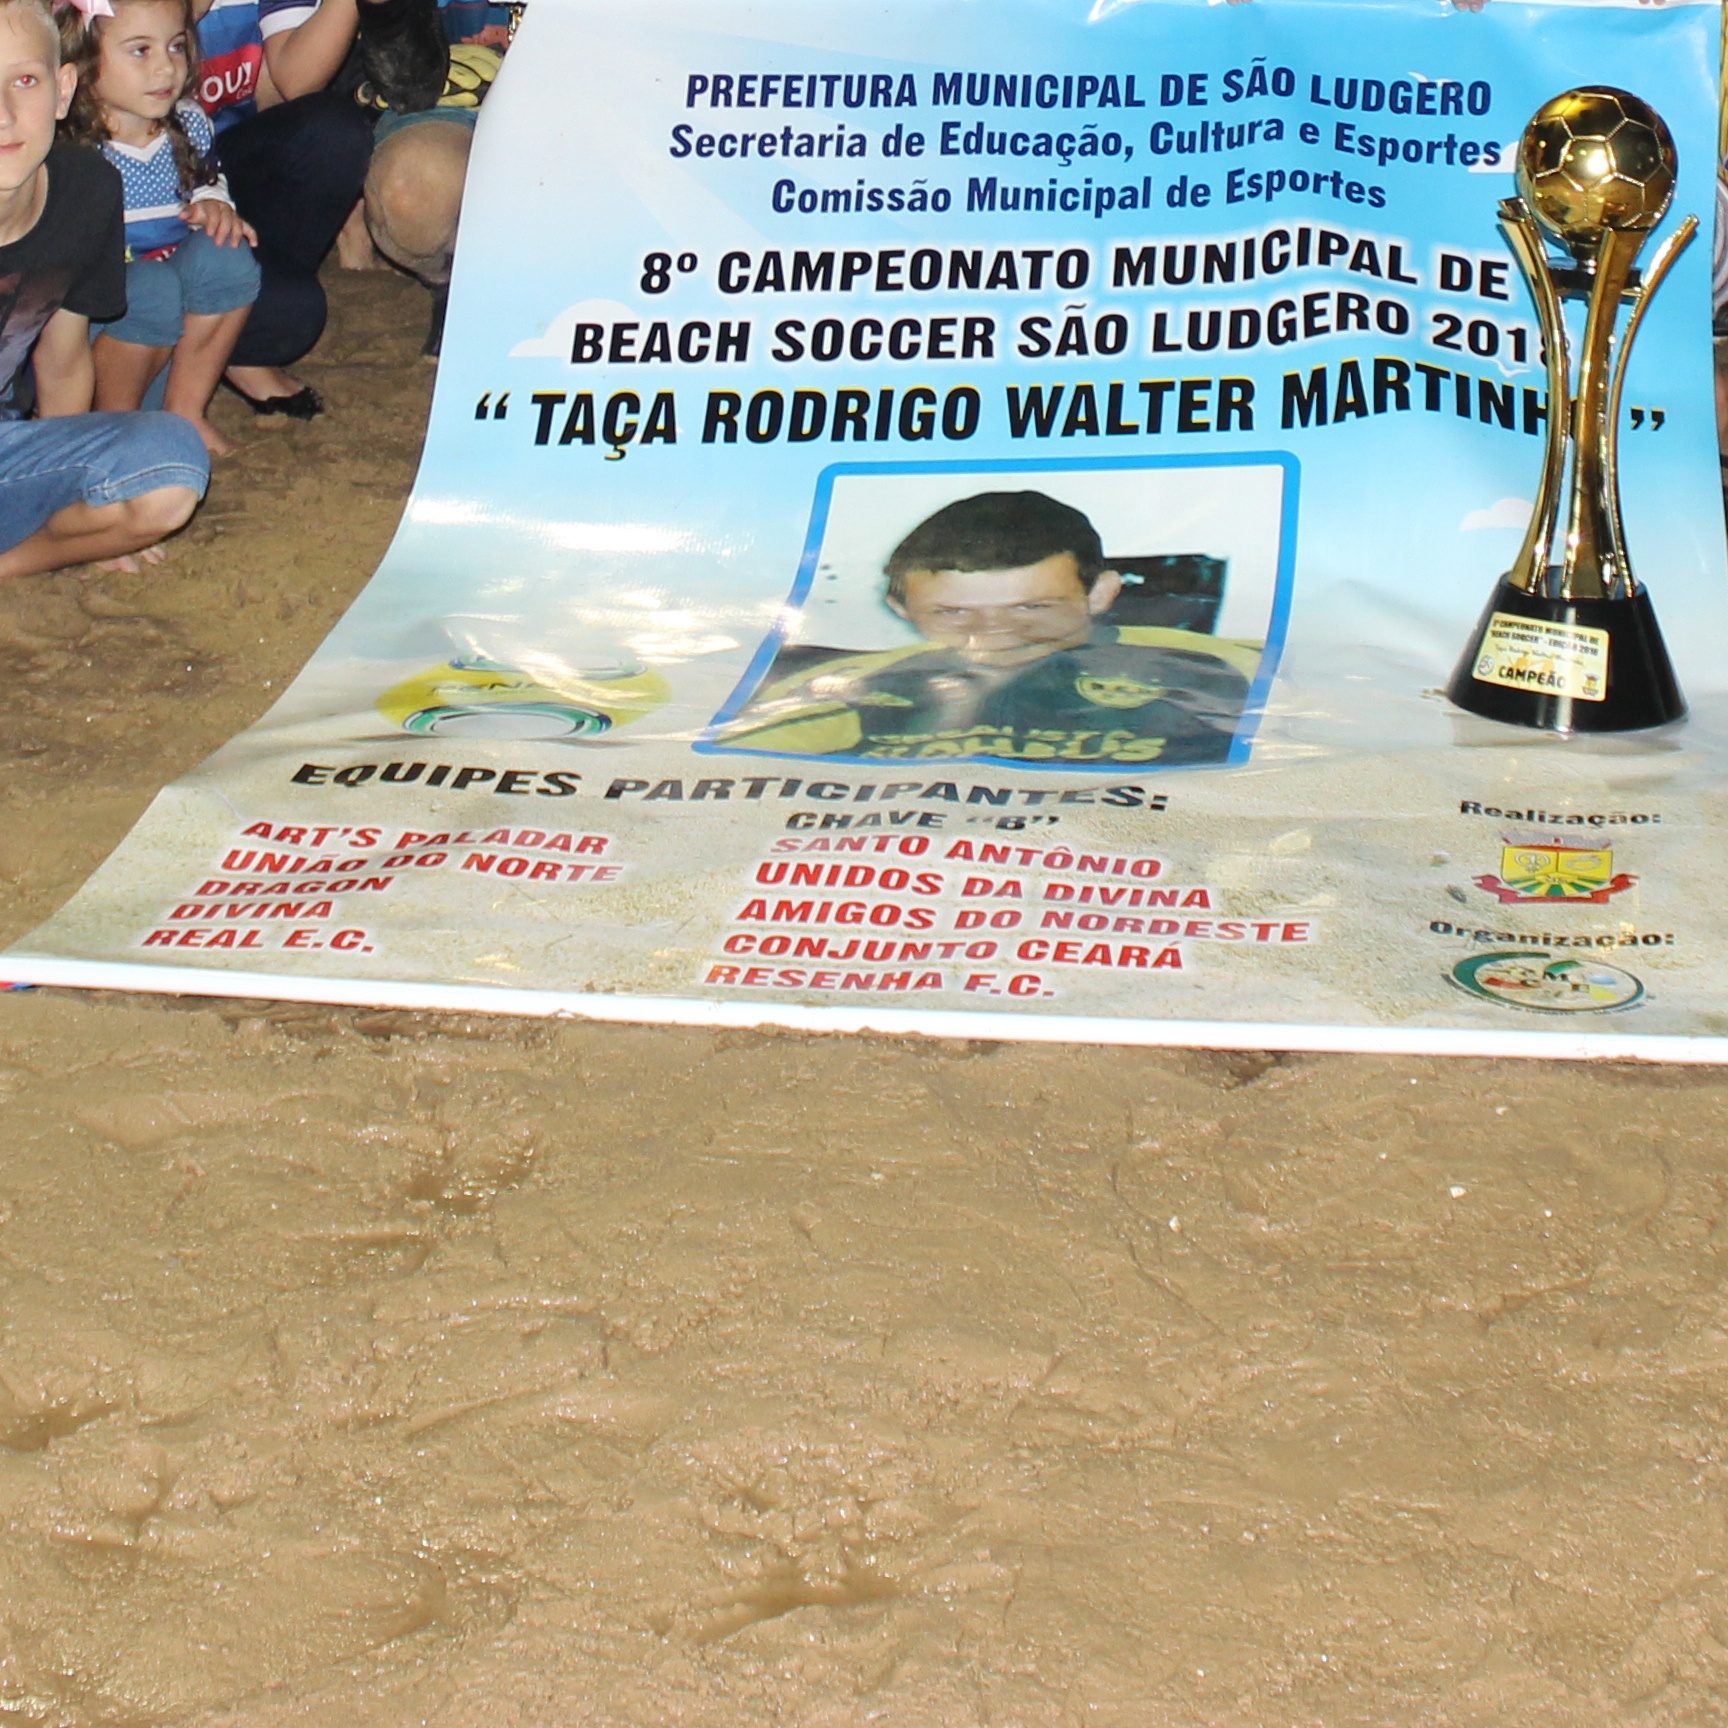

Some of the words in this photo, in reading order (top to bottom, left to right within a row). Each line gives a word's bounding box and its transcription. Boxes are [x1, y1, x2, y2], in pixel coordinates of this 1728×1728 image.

[686, 73, 918, 108] PREFEITURA
[932, 72, 1146, 108] MUNICIPAL
[1160, 73, 1209, 108] DE
[1221, 57, 1296, 104] SÃO
[1310, 73, 1492, 116] LUDGERO
[669, 123, 868, 159] Secretaria
[881, 123, 925, 157] de
[939, 121, 1135, 168] Educação,
[1149, 116, 1285, 156] Cultura
[1299, 126, 1320, 145] e
[1334, 121, 1502, 167] Esportes
[771, 178, 952, 214] Comissão
[966, 175, 1152, 219] Municipal
[1166, 174, 1211, 208] de
[1225, 167, 1387, 208] Esportes
[639, 251, 699, 294] 8º
[717, 248, 1090, 294] CAMPEONATO
[1111, 225, 1418, 288] MUNICIPAL
[1439, 252, 1511, 302] DE
[570, 320, 751, 364] BEACH
[771, 317, 996, 363] SOCCER
[1016, 302, 1129, 358] SÃO
[1151, 290, 1410, 354] LUDGERO
[530, 389, 677, 461] TAÇA
[701, 383, 981, 444] RODRIGO
[1005, 375, 1254, 440] WALTER
[1280, 355, 1578, 440] MARTINH
[1498, 664, 1567, 689] CAMPEÃO
[290, 762, 581, 797] EQUIPES
[604, 775, 1170, 812] PARTICIPANTES:
[785, 810, 948, 831] CHAVE
[1459, 800, 1662, 828] Realização:
[396, 828, 611, 855] PALADAR
[771, 835, 931, 856] SANTO
[944, 838, 1162, 879] ANTÔNIO
[220, 849, 367, 874] UNIÃO
[381, 852, 448, 870] DO
[460, 852, 624, 883] NORTE
[194, 875, 395, 898] DRAGON
[754, 861, 945, 896] UNIDOS
[961, 876, 1024, 901] DA
[1041, 882, 1212, 910] DIVINA
[168, 901, 335, 921] DIVINA
[735, 898, 937, 931] AMIGOS
[953, 909, 1022, 932] DO
[1039, 910, 1310, 943] NORDESTE
[141, 928, 265, 950] REAL
[282, 928, 376, 954] E.C.
[722, 933, 997, 962] CONJUNTO
[1016, 939, 1184, 970] CEARÁ
[1429, 920, 1676, 951] Organização:
[703, 965, 944, 992] RESENHA
[964, 972, 1056, 998] F.C.
